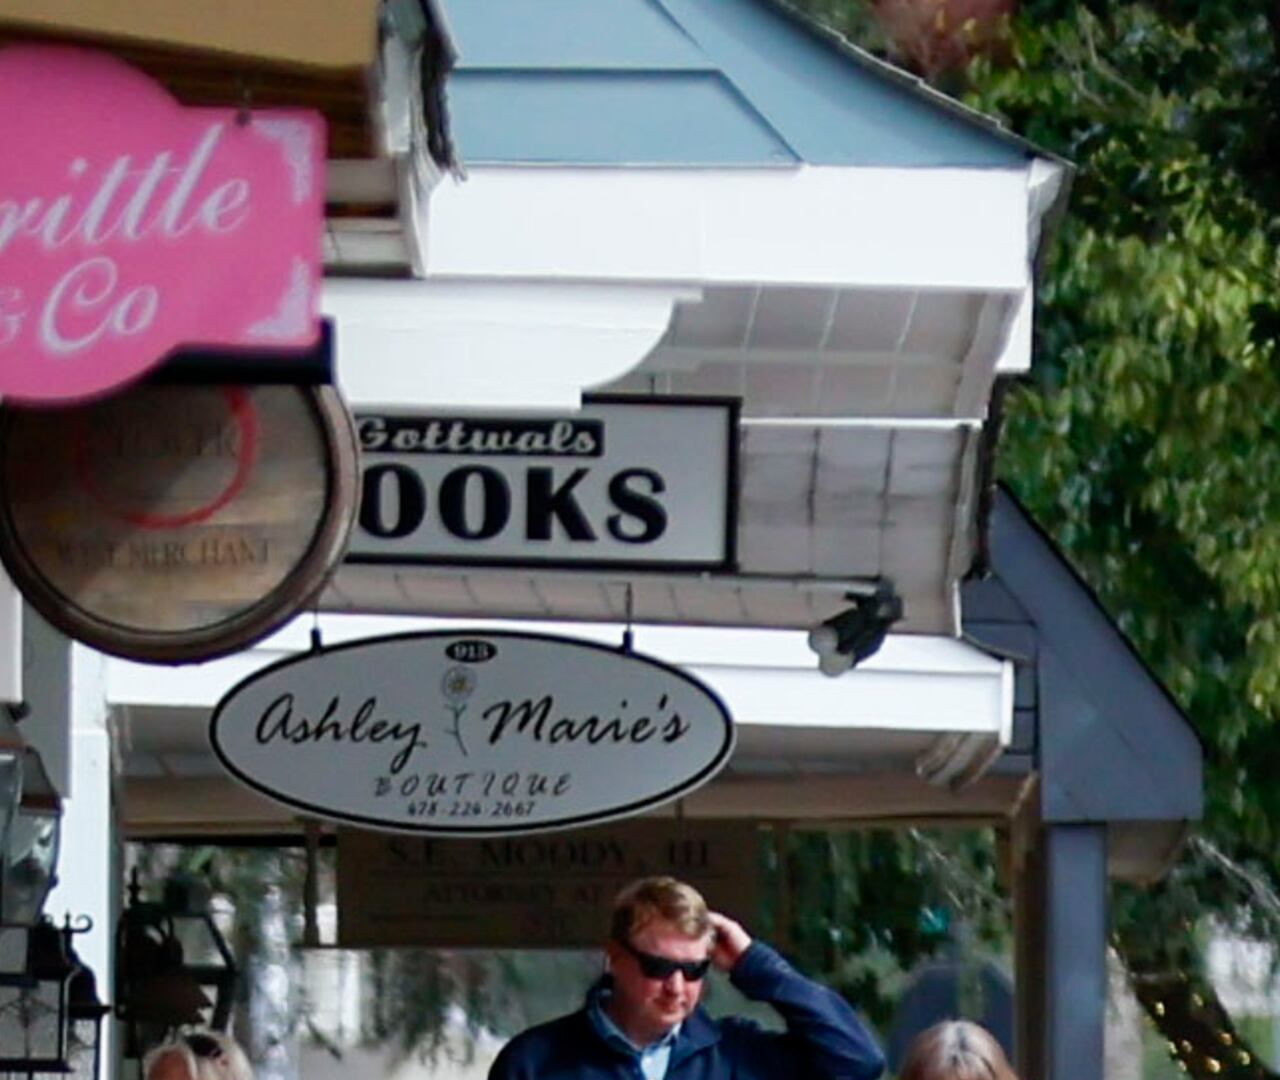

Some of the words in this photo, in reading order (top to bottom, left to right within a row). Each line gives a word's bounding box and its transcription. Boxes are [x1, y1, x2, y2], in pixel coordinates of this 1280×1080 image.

[39, 255, 160, 356] Co
[357, 417, 598, 454] Gottwals
[358, 462, 669, 545] OOKS
[256, 694, 427, 775] Ashley
[481, 694, 692, 746] Marie's
[374, 771, 572, 797] BOUTIQUE
